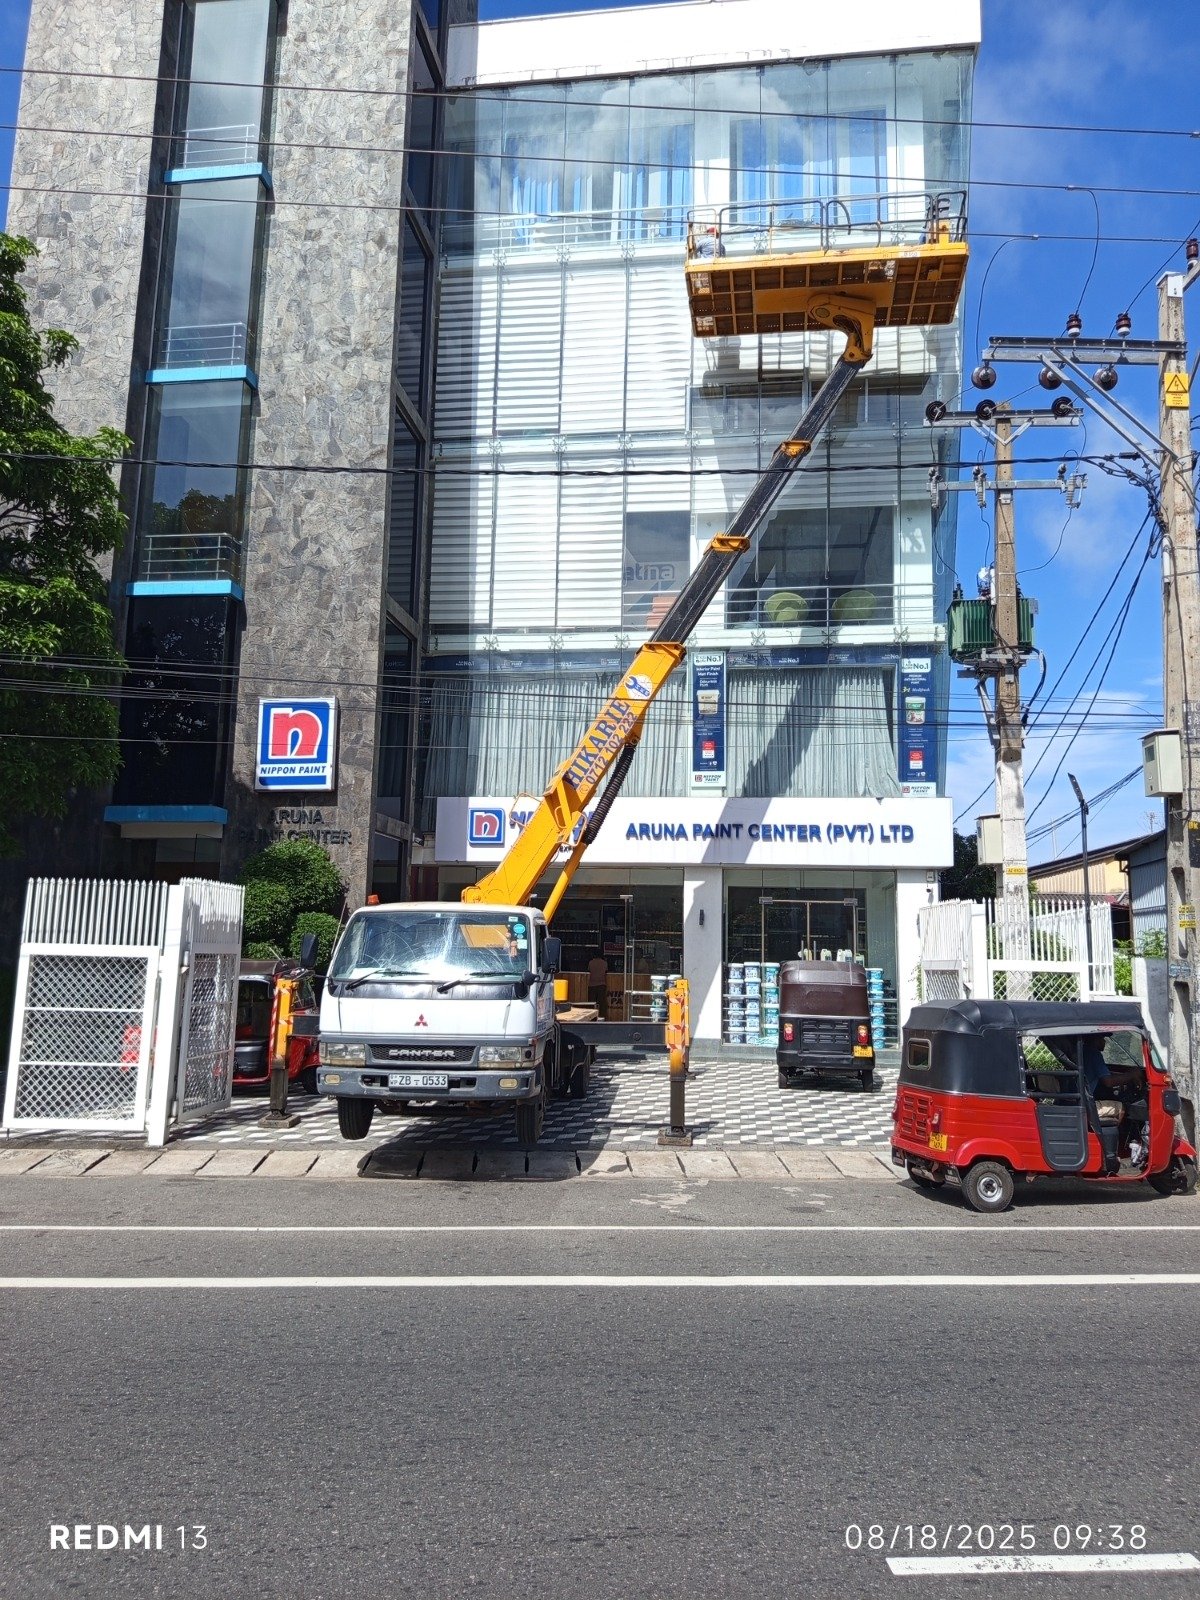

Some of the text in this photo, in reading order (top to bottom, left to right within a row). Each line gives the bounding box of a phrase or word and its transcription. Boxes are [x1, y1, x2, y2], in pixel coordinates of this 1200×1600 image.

[565, 697, 631, 788] HIKARIE
[586, 711, 638, 785] 0712 102 222
[260, 765, 326, 775] NIPPON PAINT
[269, 809, 325, 825] ARUNA
[626, 822, 915, 845] ARUNA PAINT CENTER (PVT) LTD
[388, 1049, 456, 1058] CANTER
